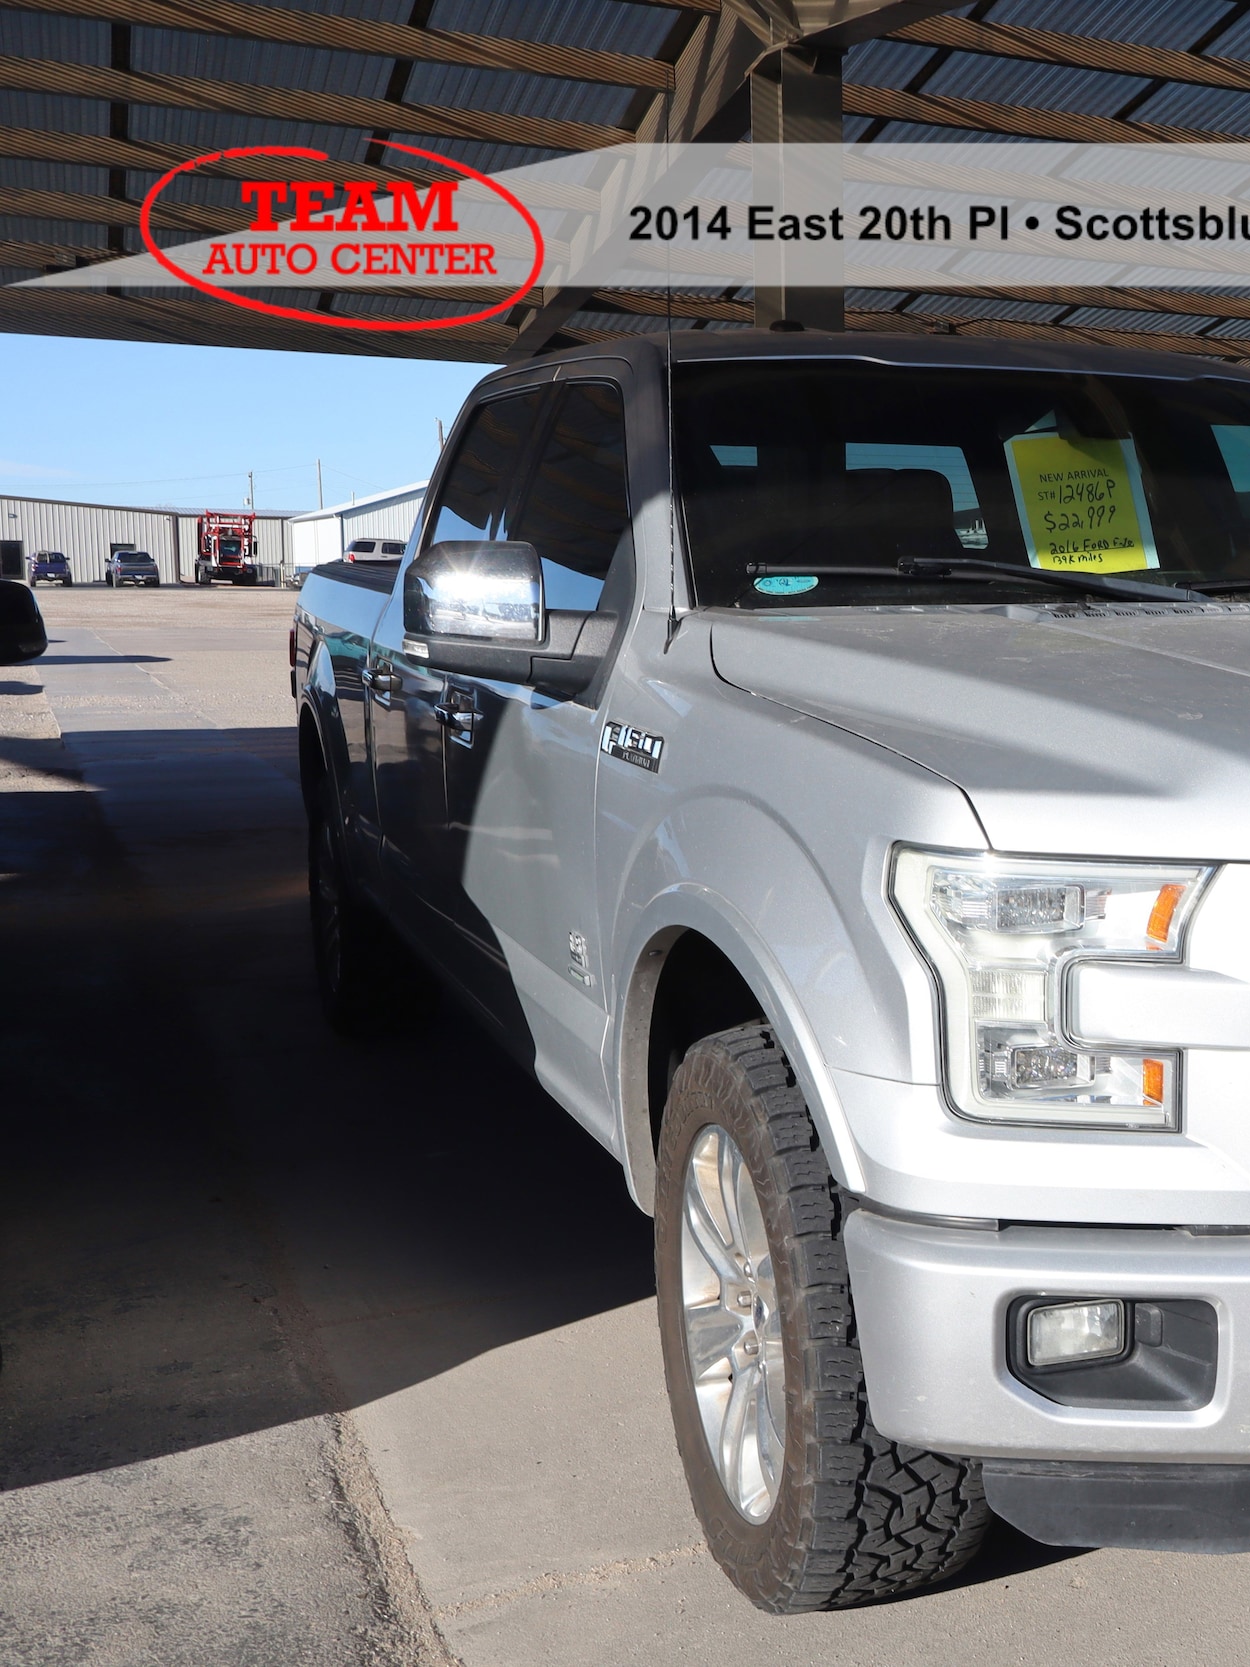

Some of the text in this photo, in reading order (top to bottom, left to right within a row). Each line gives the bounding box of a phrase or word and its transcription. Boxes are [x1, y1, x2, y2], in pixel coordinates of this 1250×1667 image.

[1039, 468, 1109, 483] NEW ARRIVAL
[1044, 505, 1116, 533] $22,999
[1049, 539, 1079, 555] 2016
